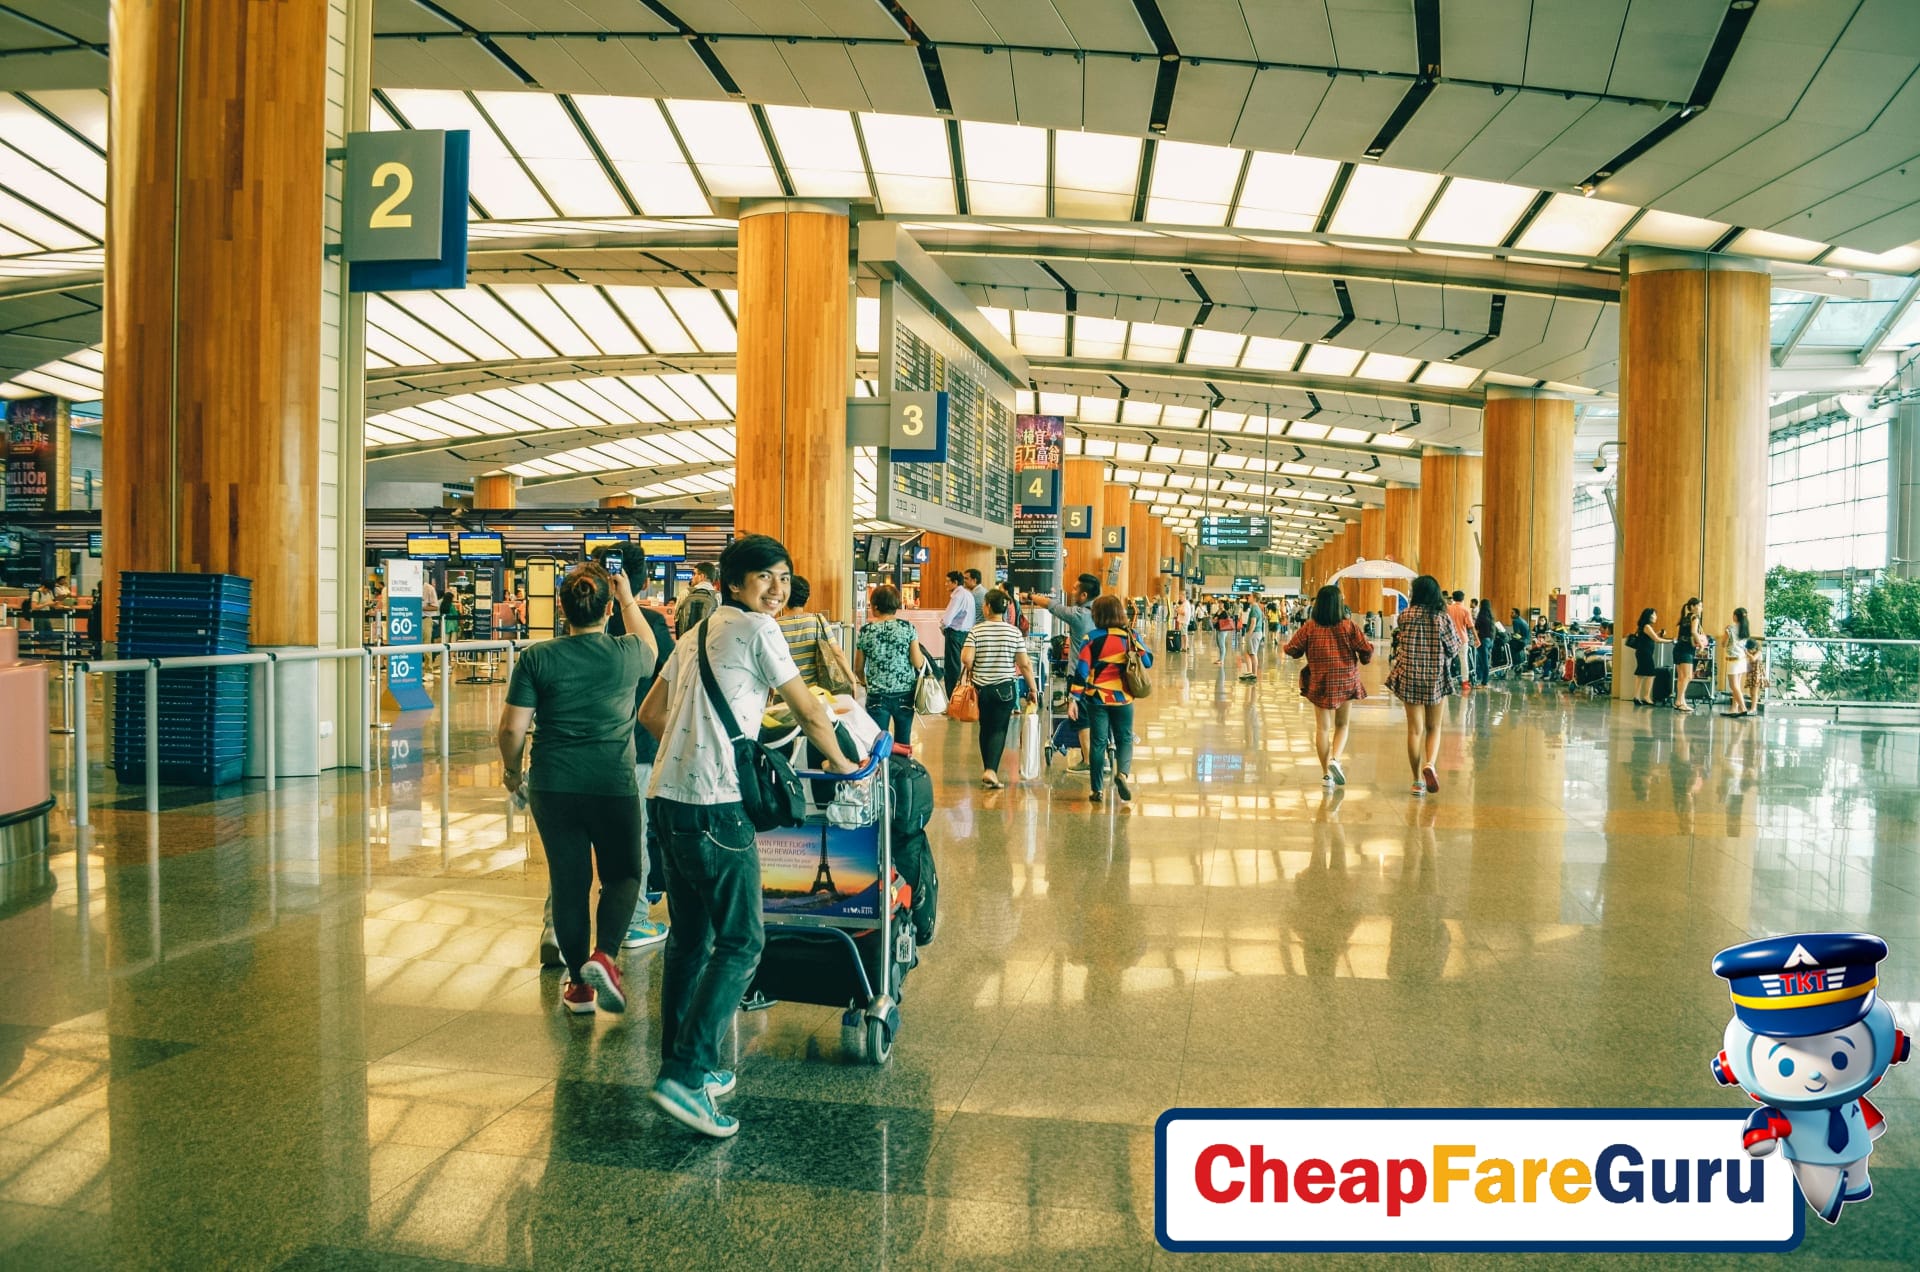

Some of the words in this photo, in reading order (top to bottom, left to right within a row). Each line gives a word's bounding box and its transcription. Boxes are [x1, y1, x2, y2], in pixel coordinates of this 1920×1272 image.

[369, 162, 414, 228] 2
[902, 404, 924, 436] 3
[1028, 478, 1043, 498] 4
[1070, 512, 1081, 526] 5
[1108, 531, 1117, 544] 6
[916, 549, 927, 561] 4
[391, 618, 412, 634] 60
[391, 661, 409, 678] 10
